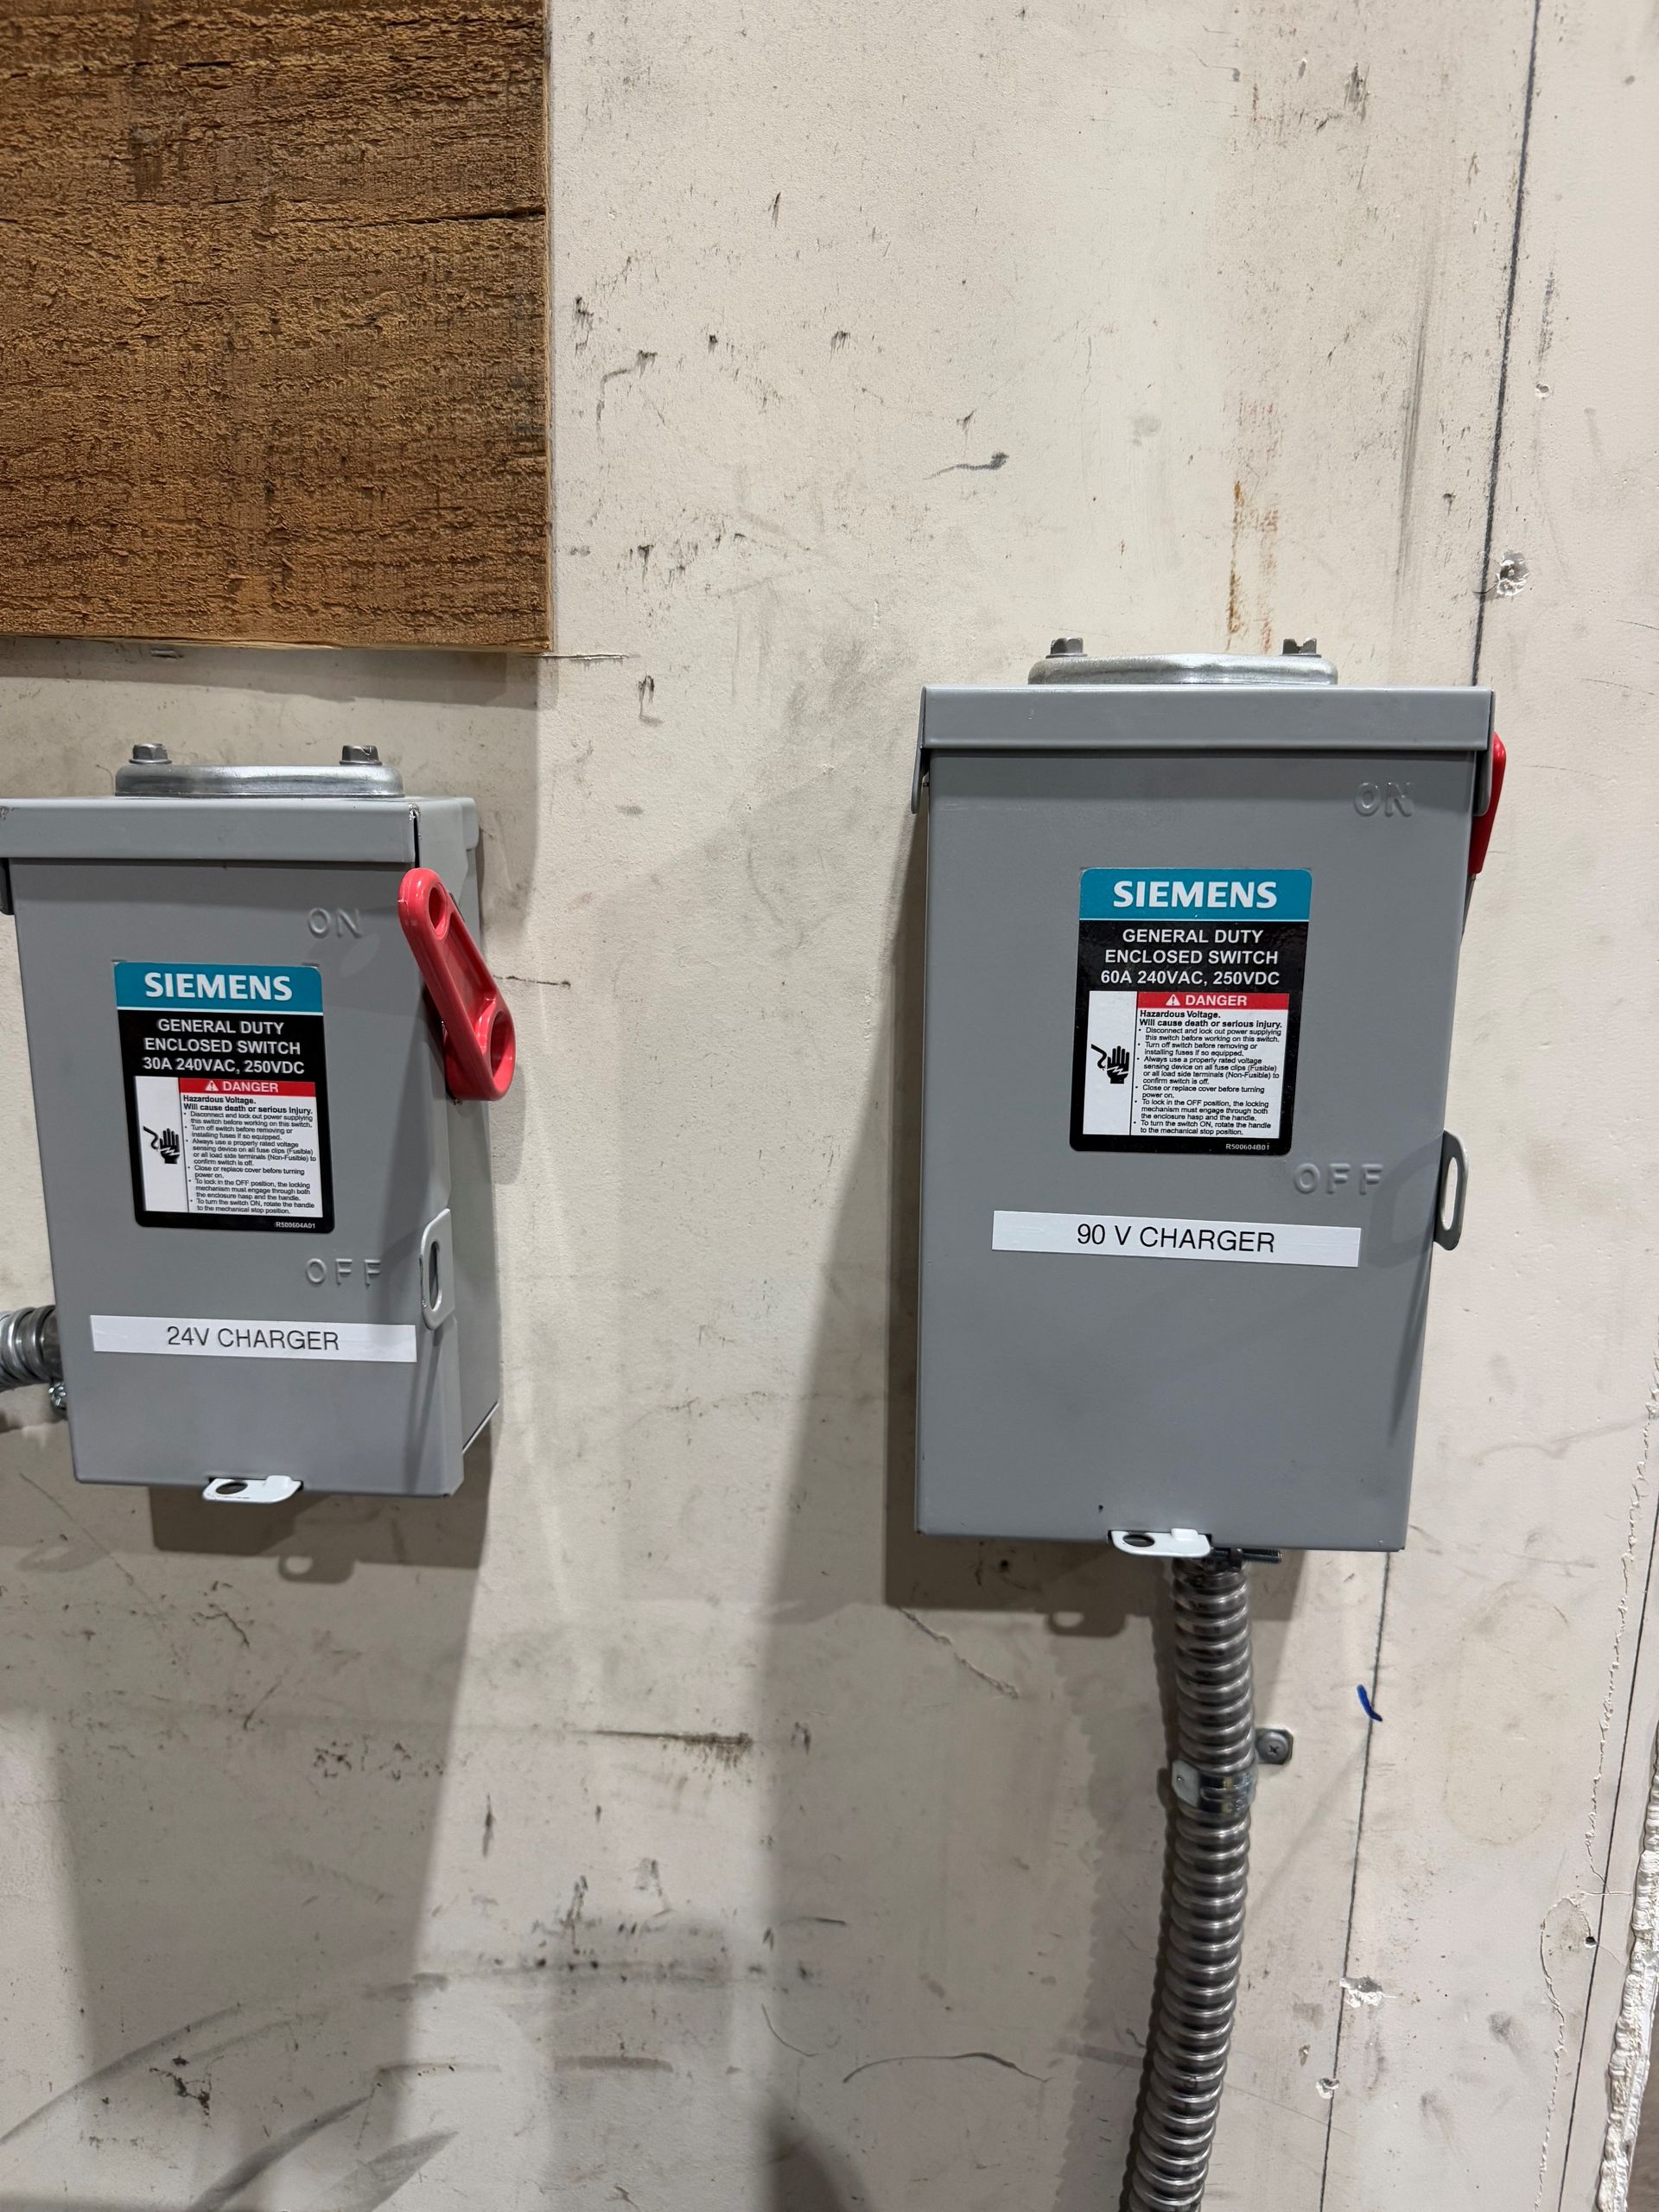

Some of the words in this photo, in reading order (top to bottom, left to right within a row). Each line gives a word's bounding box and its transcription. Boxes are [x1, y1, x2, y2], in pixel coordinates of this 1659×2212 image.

[1354, 781, 1414, 817] ON
[1113, 880, 1277, 908] SIEMENS
[308, 907, 361, 938] ON
[1122, 929, 1208, 943] GENERAL
[1215, 930, 1263, 944] DUTY
[1105, 950, 1202, 963] ENCLOSED
[1208, 951, 1278, 964] SWITCH
[1101, 970, 1131, 983] 60A
[1137, 971, 1207, 986] 240VAC,
[1213, 972, 1279, 985] 250VDC
[144, 972, 293, 1001] SIEMENS
[1185, 995, 1247, 1006] DANGER
[1187, 1011, 1221, 1020] Voltage.
[157, 1019, 236, 1033] GENERAL
[240, 1020, 283, 1035] DUTY
[1256, 1020, 1282, 1029] injury.
[144, 1038, 232, 1052] ENCLOSED
[237, 1041, 301, 1054] SWITCH
[143, 1058, 172, 1070] 30A
[176, 1058, 240, 1074] 240VAC,
[245, 1060, 304, 1074] 250VDC
[223, 1082, 278, 1092] DANGER
[1295, 1162, 1382, 1194] OFF
[1077, 1223, 1106, 1245] 90
[1114, 1226, 1132, 1246] V
[1140, 1226, 1275, 1253] CHARGER
[305, 1258, 381, 1286] OFF
[167, 1325, 209, 1345] 24V
[219, 1328, 339, 1351] CHARGER
